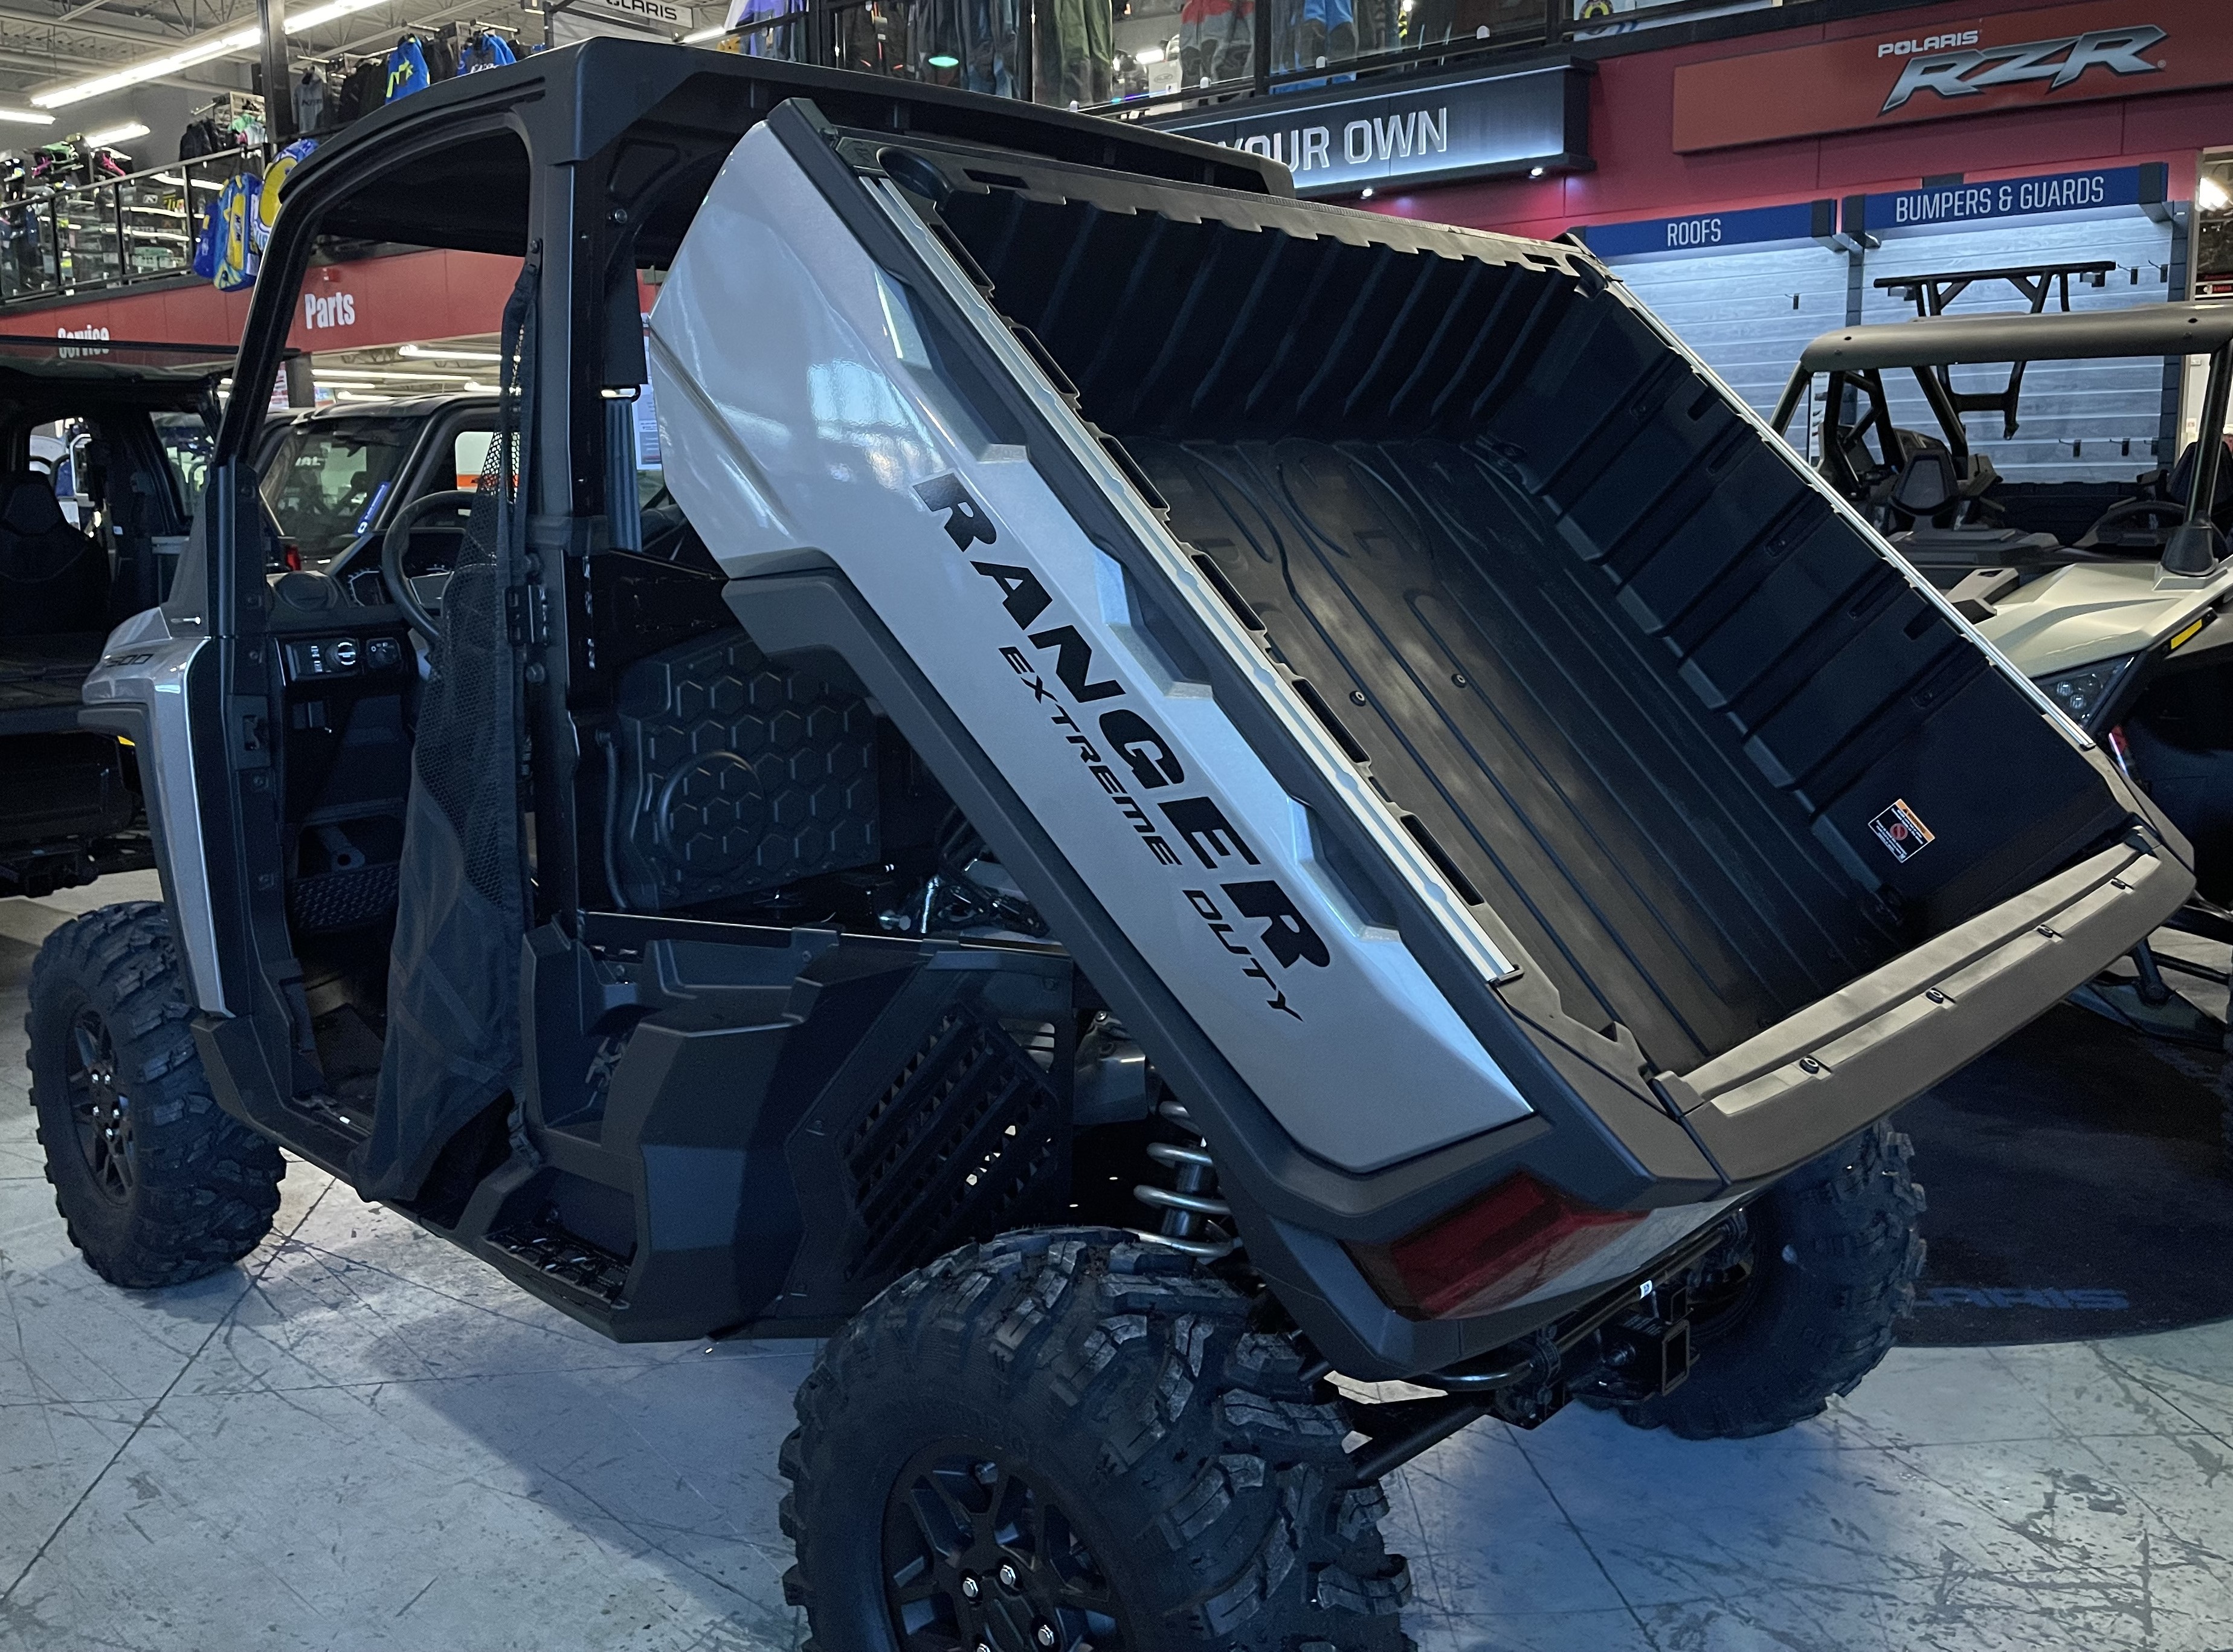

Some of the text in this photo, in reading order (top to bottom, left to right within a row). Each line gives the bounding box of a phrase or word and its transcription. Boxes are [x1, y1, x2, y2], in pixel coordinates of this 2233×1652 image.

[607, 0, 677, 20] LARIS
[1878, 30, 1979, 57] POLARIS
[1344, 107, 1448, 164] OWN
[1895, 176, 2105, 222] BUMPERS & GUARDS
[1667, 218, 1722, 247] ROOFS
[304, 292, 355, 329] Parts
[912, 472, 1330, 969] RANGER
[998, 646, 1304, 1023] EXTREME DUTY
